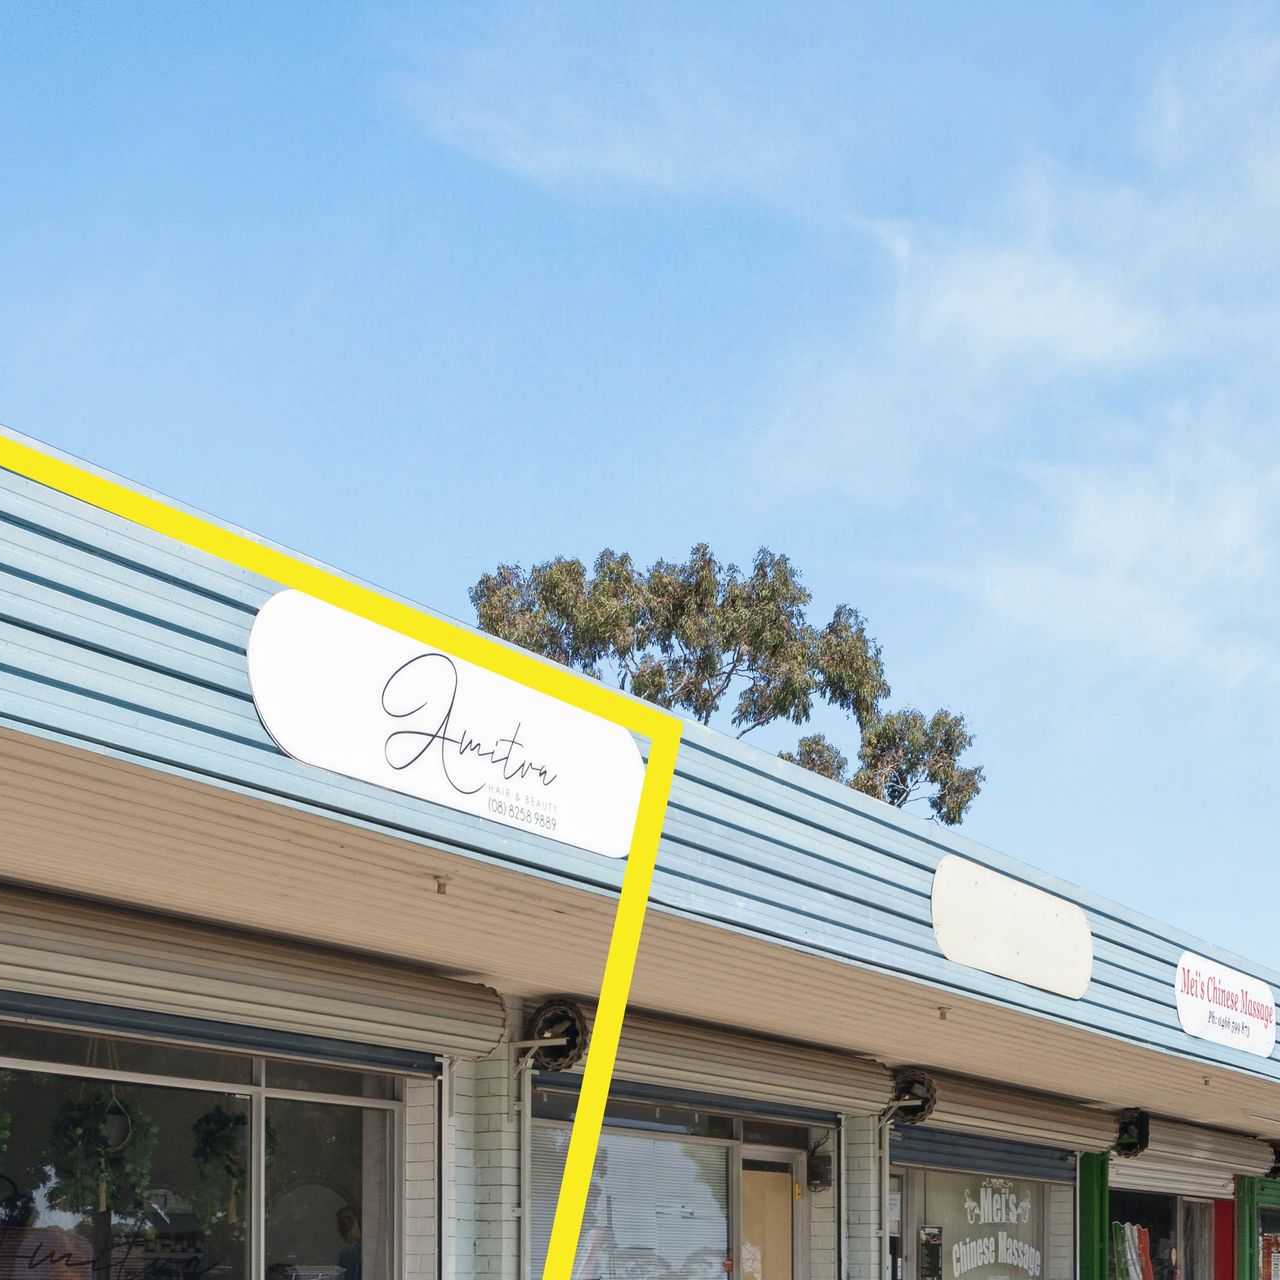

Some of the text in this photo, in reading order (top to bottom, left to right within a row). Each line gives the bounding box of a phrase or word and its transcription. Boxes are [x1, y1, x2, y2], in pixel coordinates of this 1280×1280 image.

[381, 652, 558, 795] Amitra
[488, 797, 557, 831] (08) 8258 9889
[1180, 966, 1274, 1030] Mei's Chinese Massage
[980, 1187, 1017, 1222] Mei's
[952, 1238, 996, 1278] Chinese
[998, 1231, 1041, 1276] Massage
